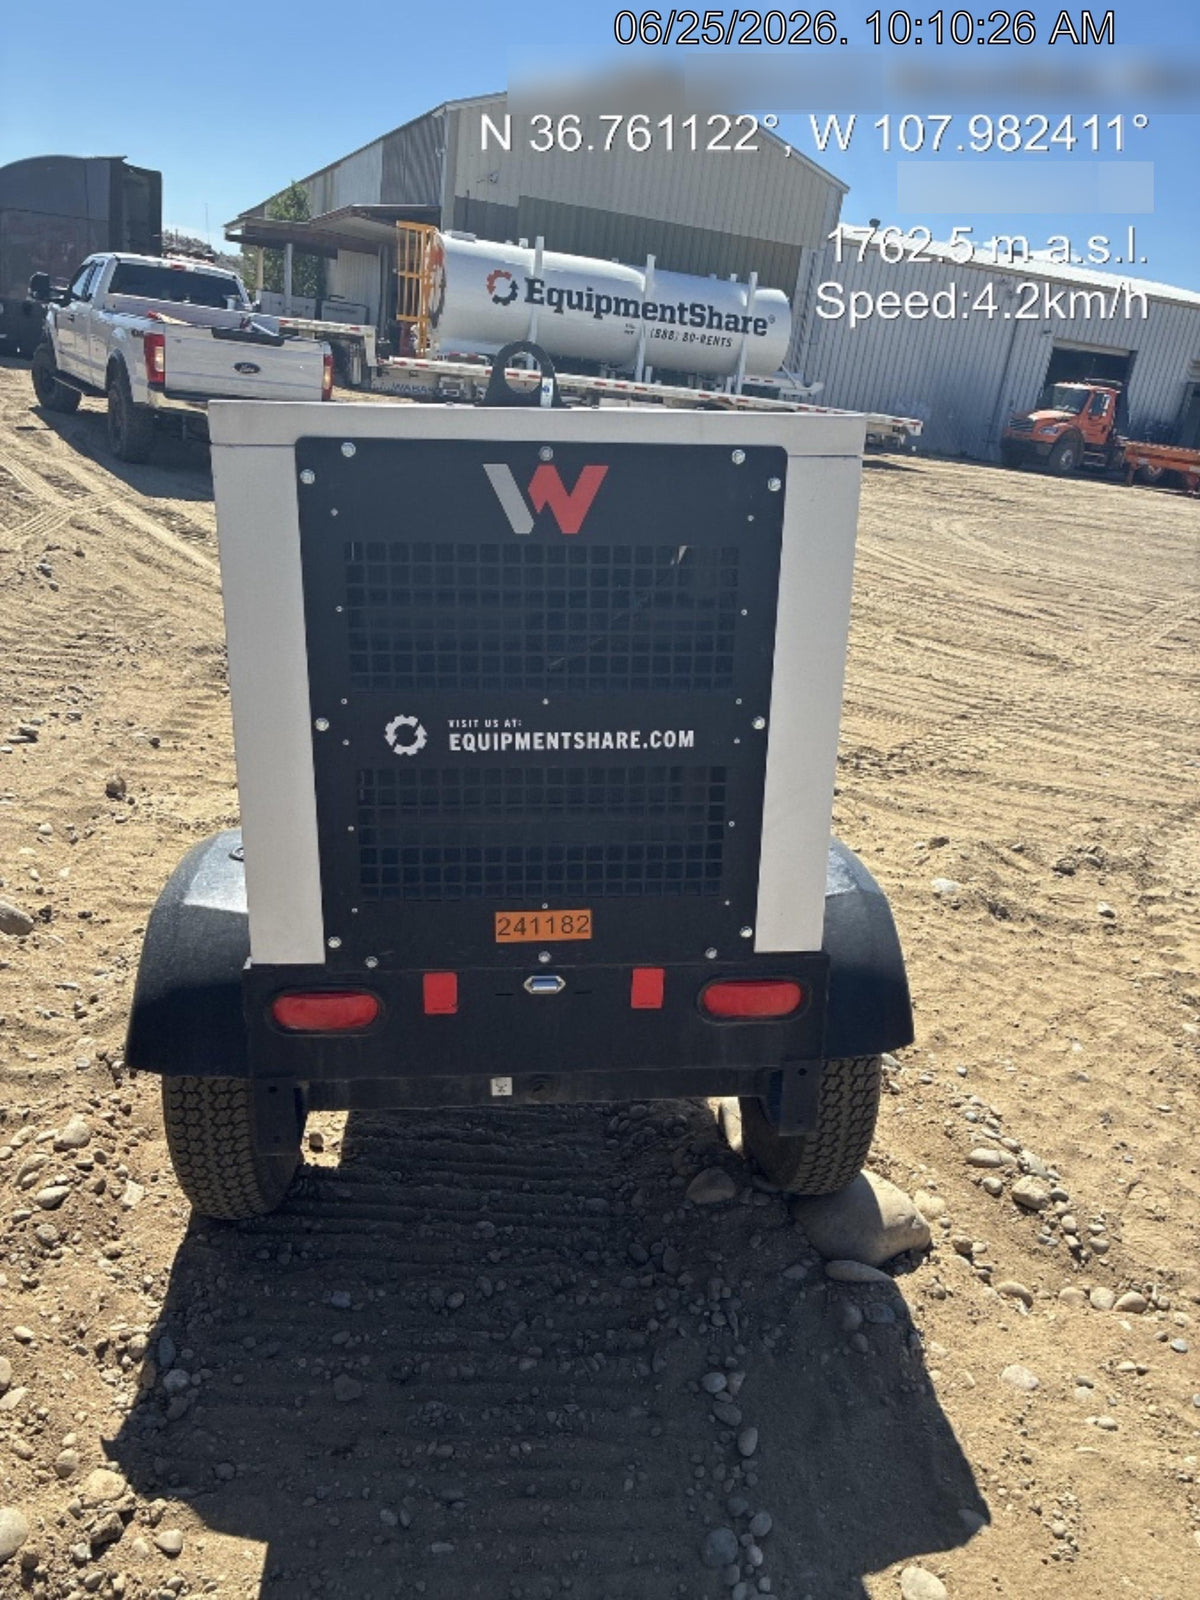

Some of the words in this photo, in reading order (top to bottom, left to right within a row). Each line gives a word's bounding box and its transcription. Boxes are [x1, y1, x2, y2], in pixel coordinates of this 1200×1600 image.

[447, 719, 480, 729] VISIT
[484, 719, 500, 729] US
[504, 718, 523, 729] AT:
[448, 730, 696, 753] EQUIPMENTSHARE.COM
[497, 914, 591, 937] 241182
